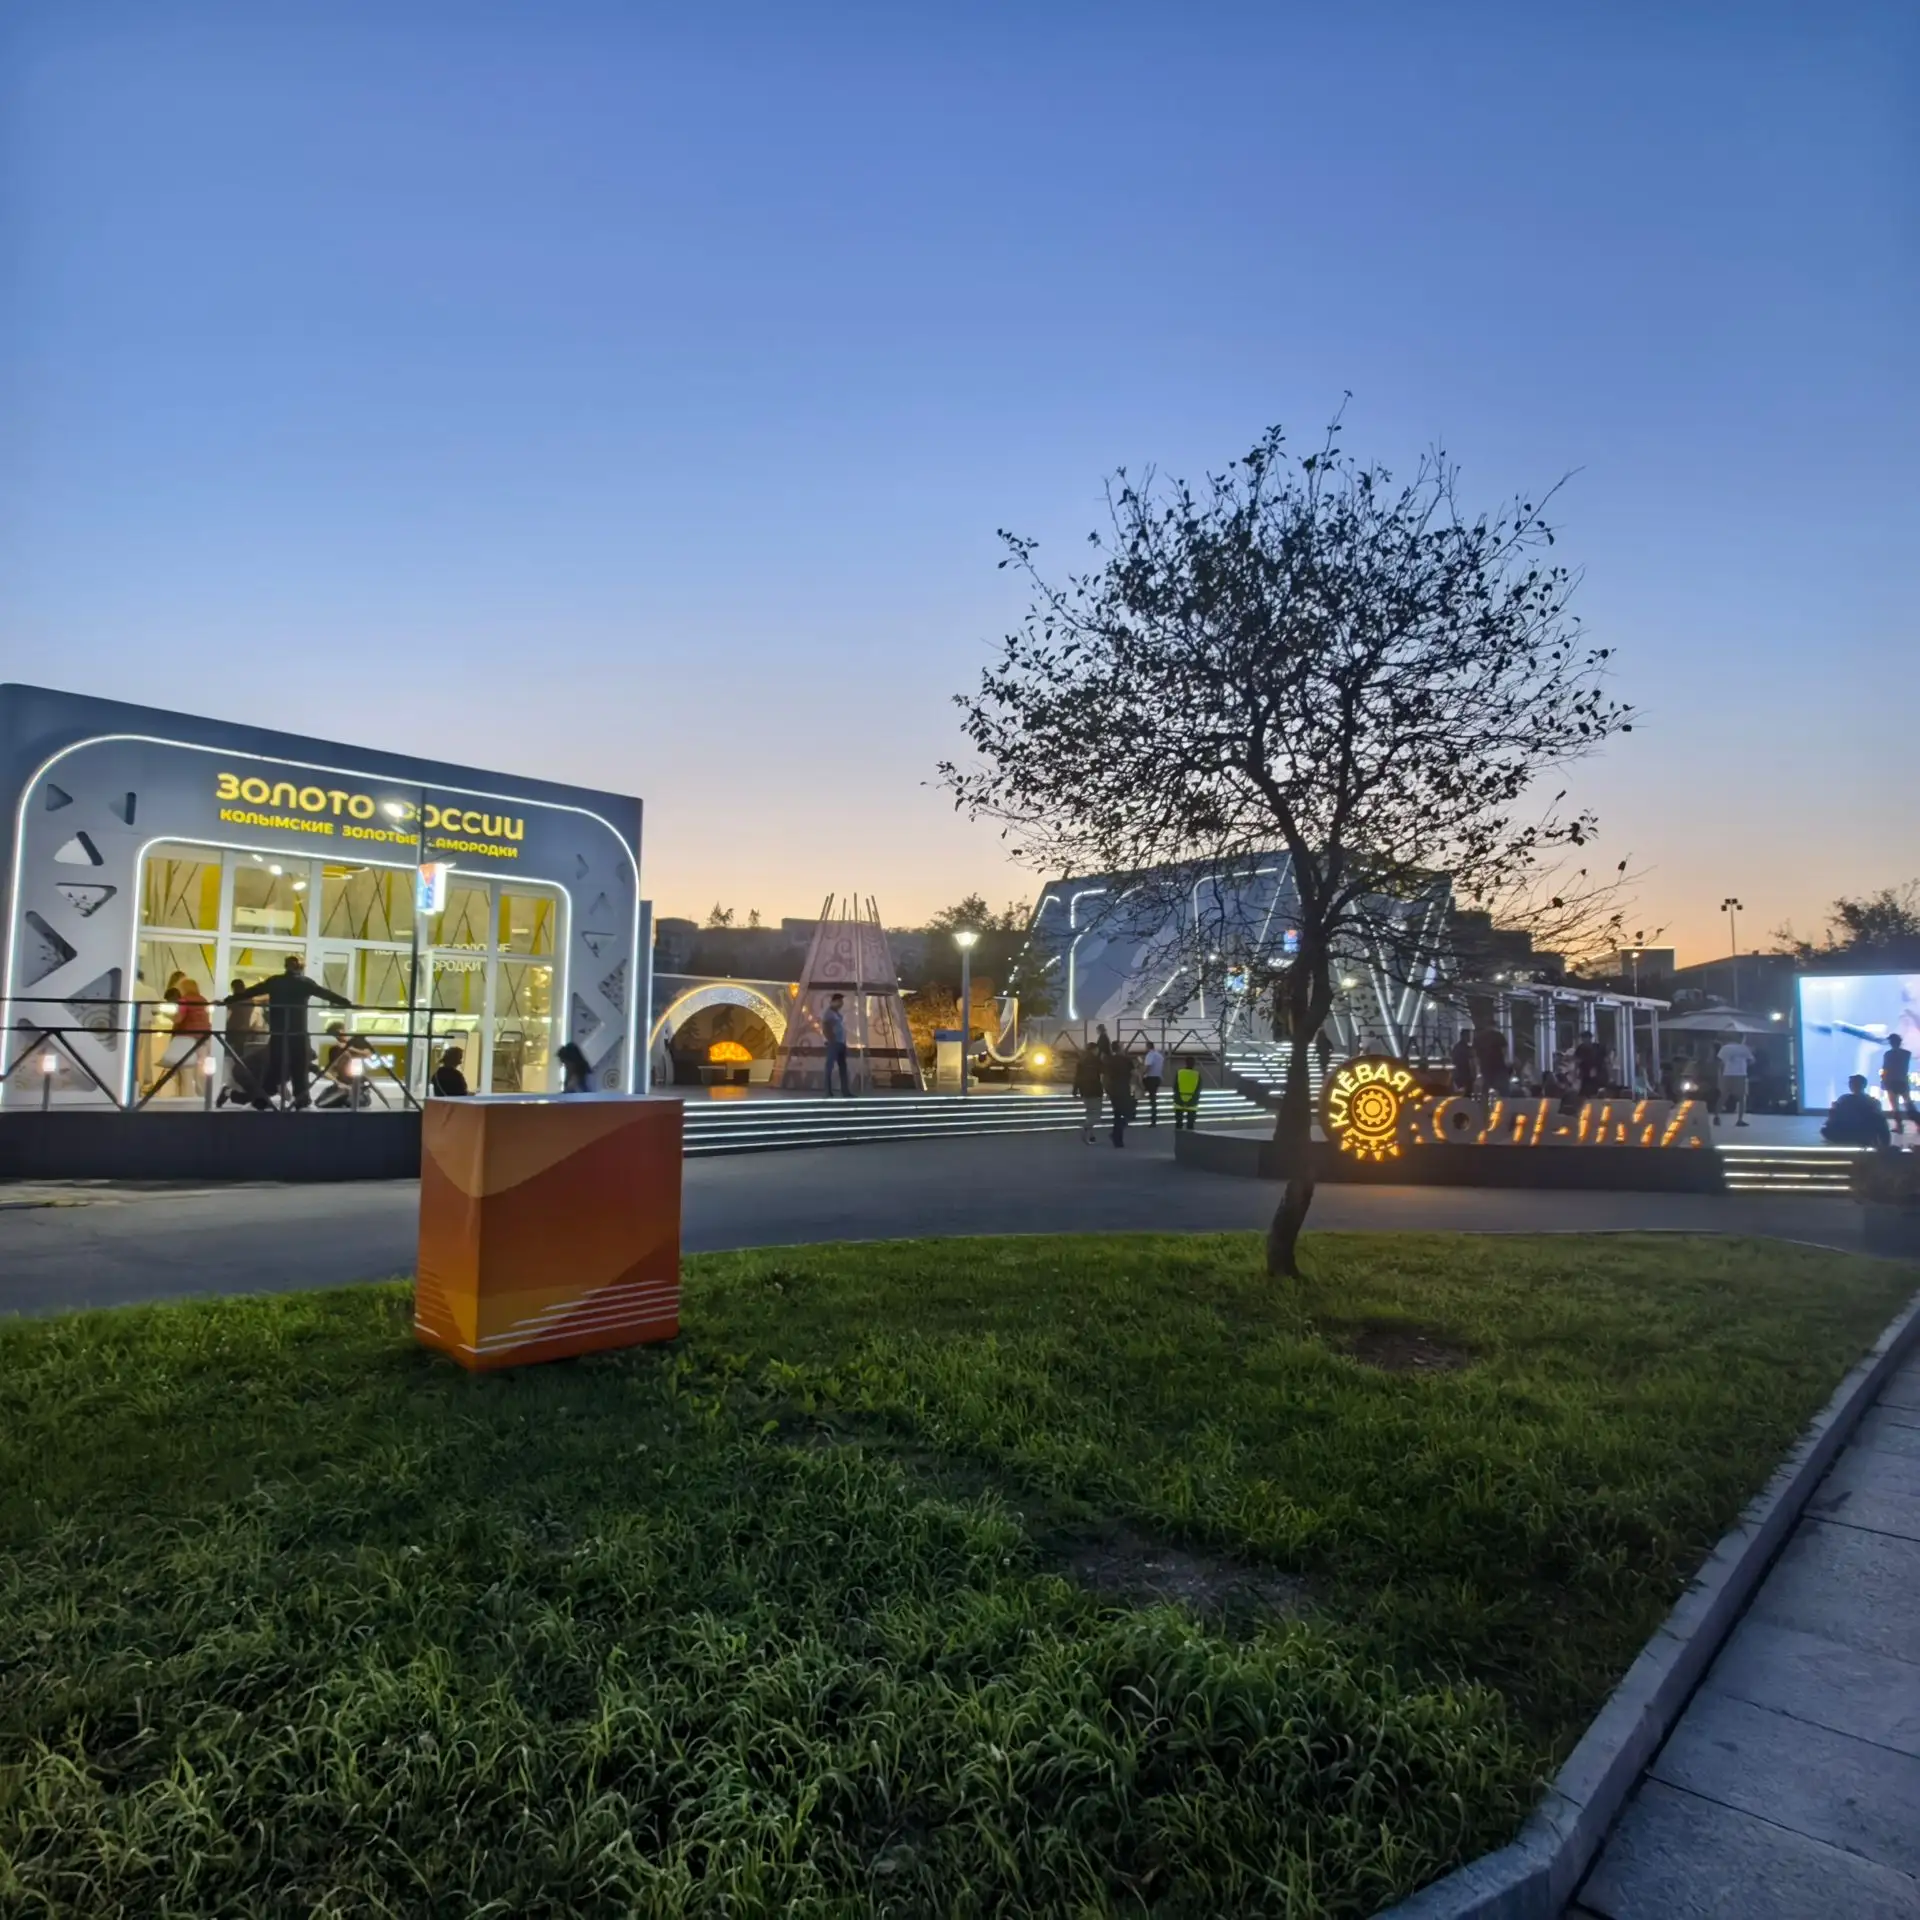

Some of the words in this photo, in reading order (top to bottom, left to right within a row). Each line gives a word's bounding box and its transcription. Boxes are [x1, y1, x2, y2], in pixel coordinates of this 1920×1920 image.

[215, 772, 376, 820] ЗОЛОТО
[219, 808, 335, 836] КОЛЫМСКИЕ
[341, 824, 419, 846] ЗОЛОТЫЕ
[427, 837, 518, 859] АМОРОДКИ
[1327, 1062, 1413, 1128] КЛЁВАЯ
